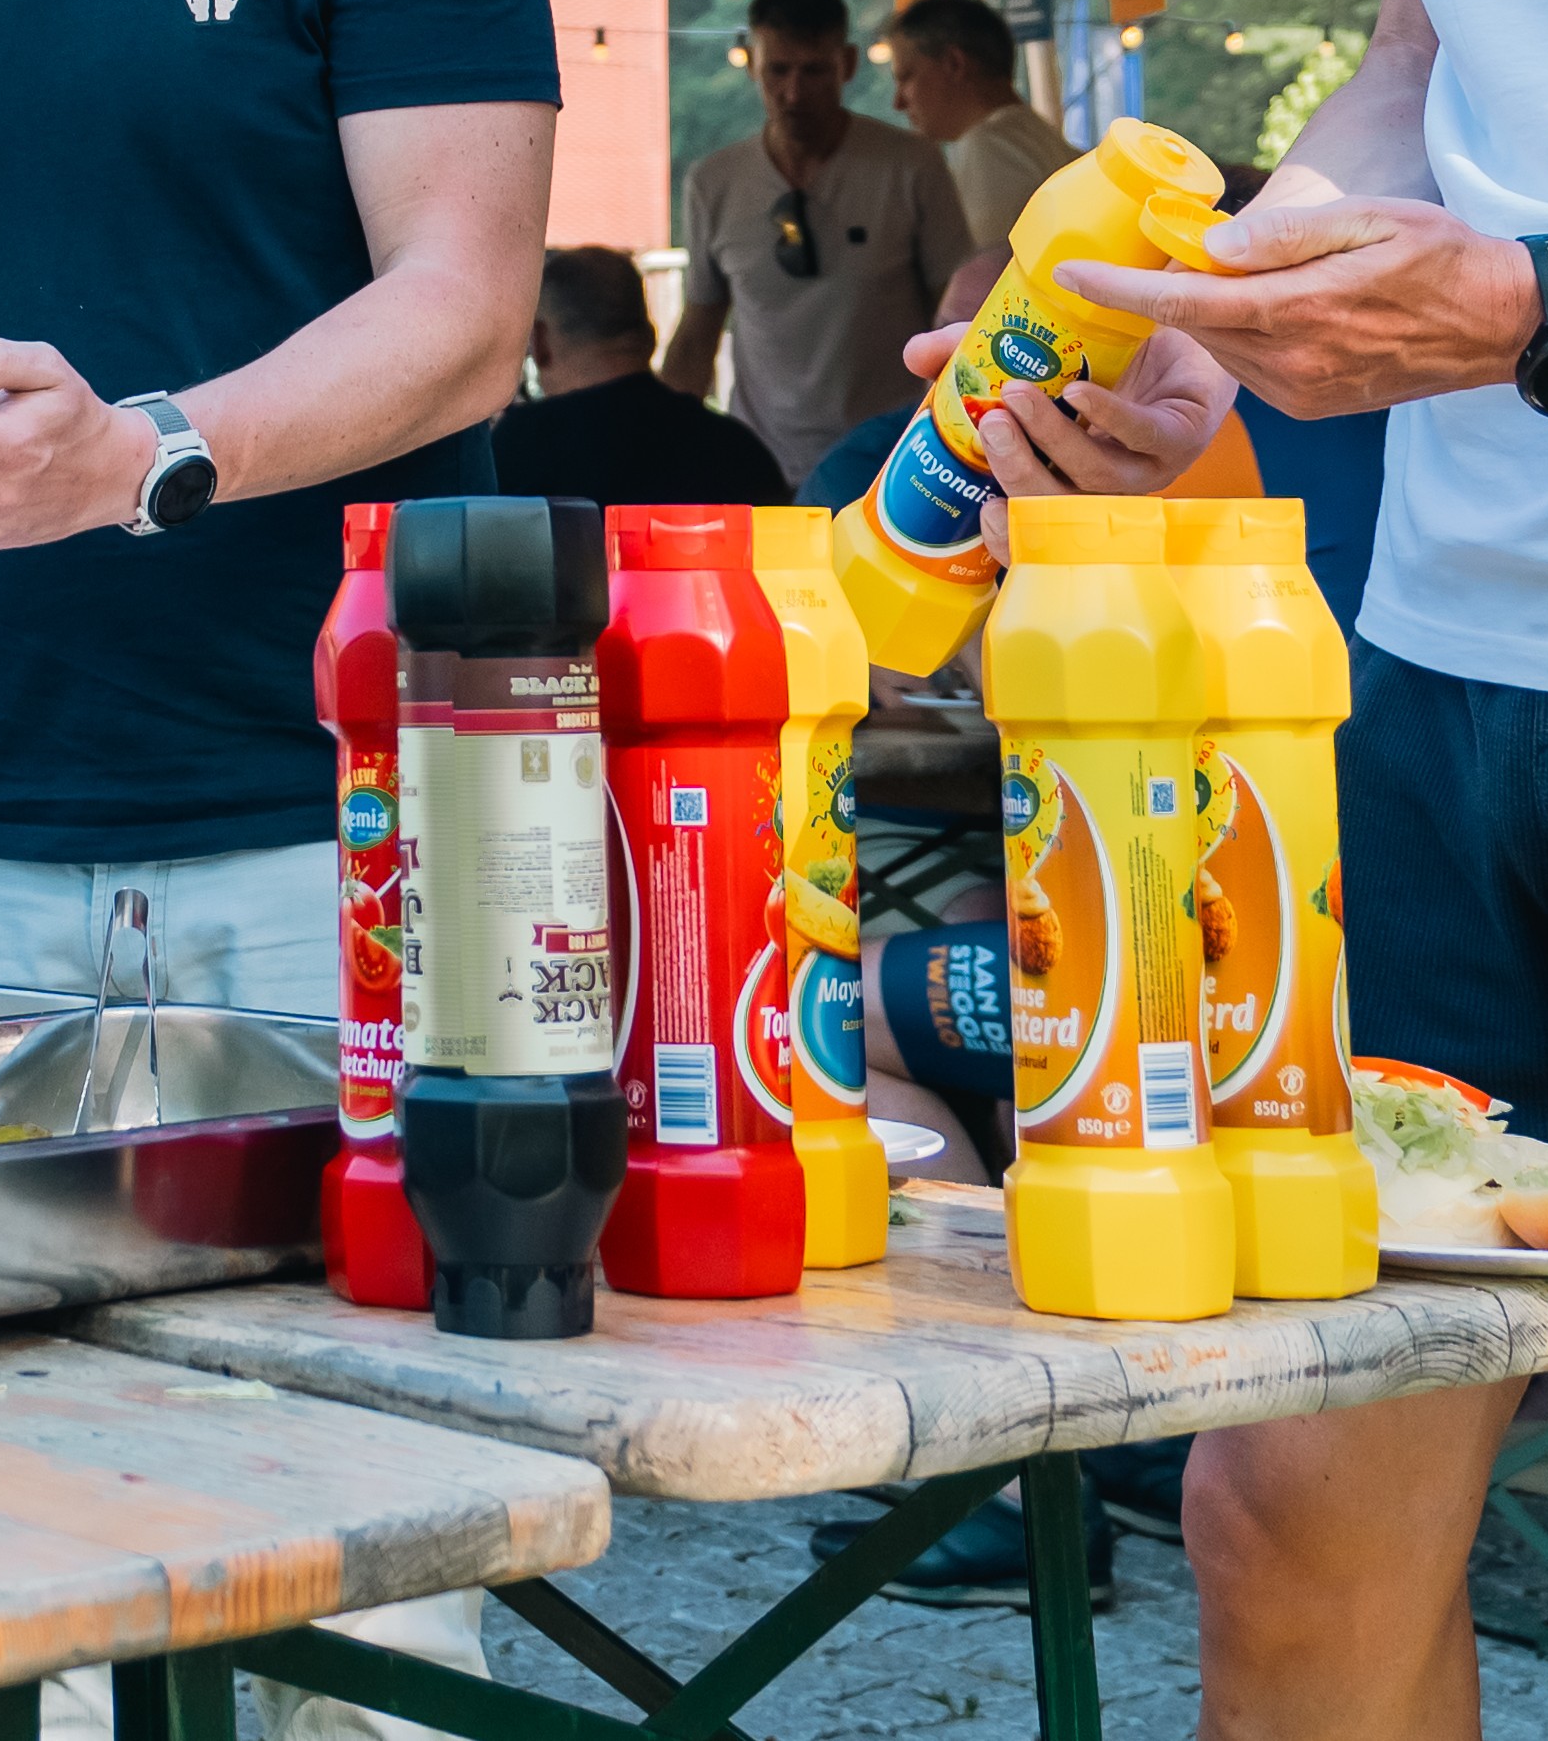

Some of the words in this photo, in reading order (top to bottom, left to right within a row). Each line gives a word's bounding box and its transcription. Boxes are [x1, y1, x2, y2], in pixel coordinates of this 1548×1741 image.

[1002, 313, 1029, 331] LANG
[1030, 322, 1059, 346] LEVE
[1000, 333, 1050, 377] Remia
[909, 431, 998, 505] Mayonais
[909, 474, 931, 498] Extra
[931, 495, 962, 519] romig
[510, 676, 587, 695] BLACK
[353, 767, 378, 787] LEVE
[341, 805, 389, 833] Remia
[973, 944, 1002, 1014] AAN
